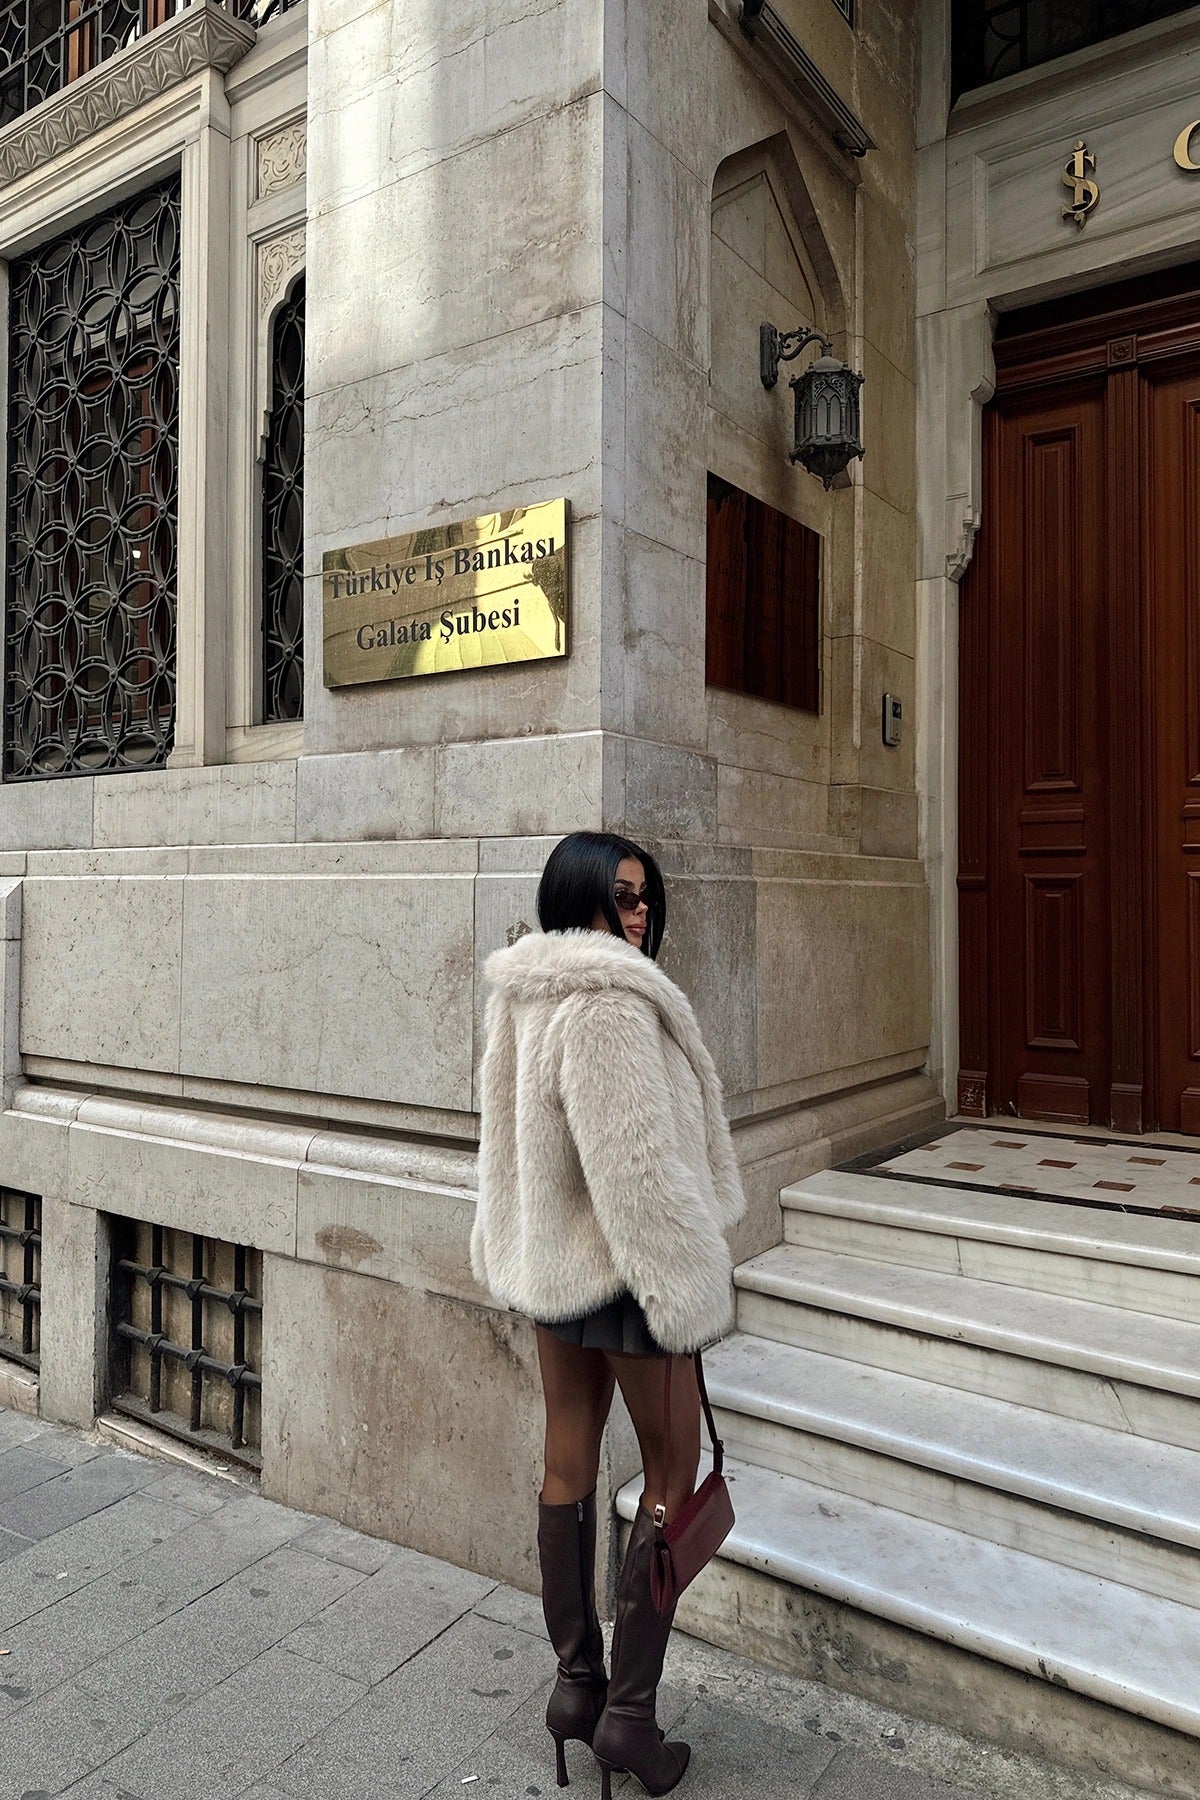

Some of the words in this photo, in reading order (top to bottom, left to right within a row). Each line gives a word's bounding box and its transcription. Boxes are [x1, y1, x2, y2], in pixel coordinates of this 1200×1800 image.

[329, 563, 417, 599] Türkiye
[454, 537, 556, 576] Bankası
[356, 618, 432, 650] Galata
[439, 599, 521, 643] Şubesi
